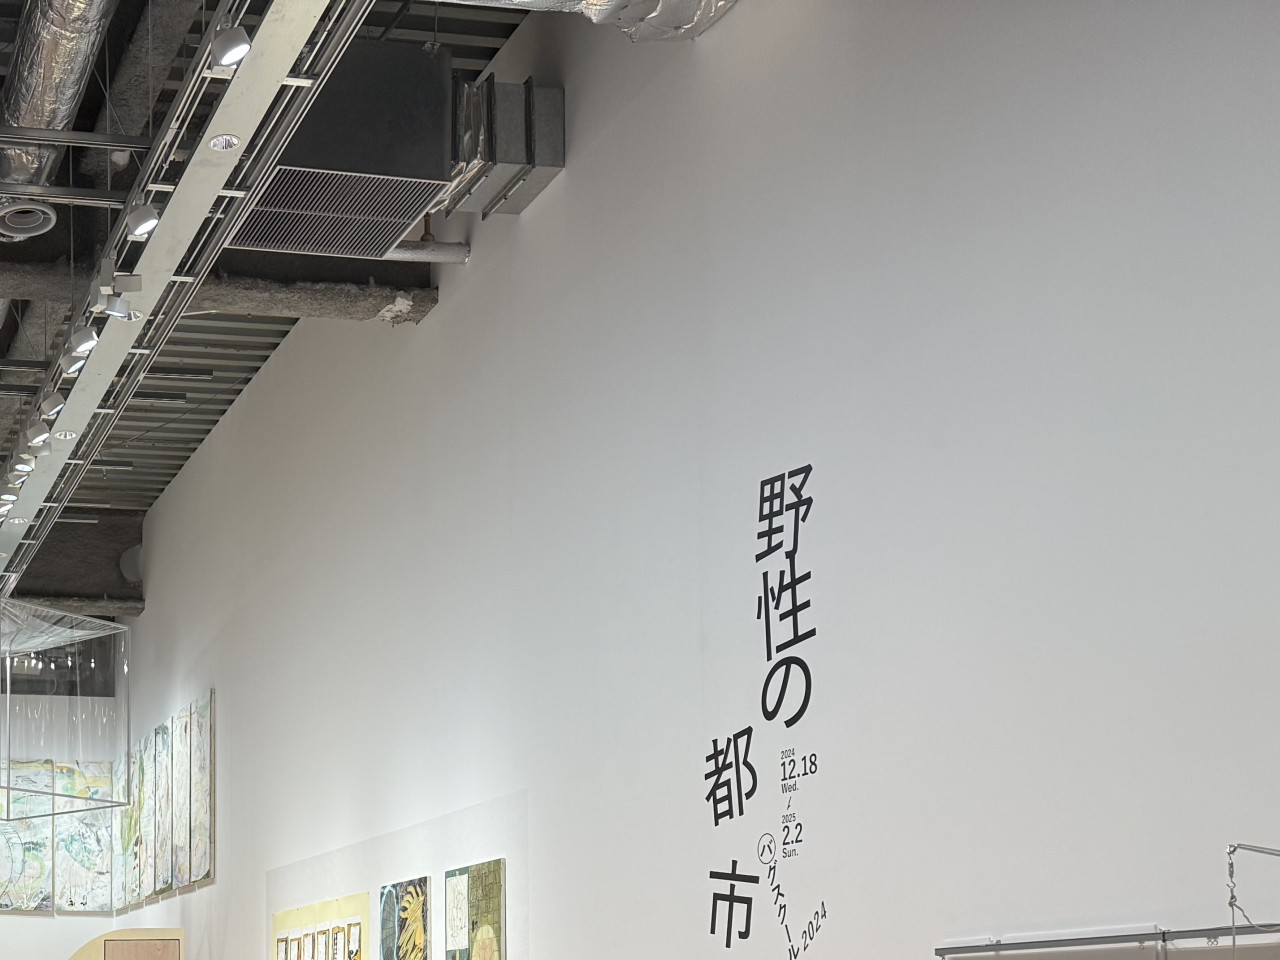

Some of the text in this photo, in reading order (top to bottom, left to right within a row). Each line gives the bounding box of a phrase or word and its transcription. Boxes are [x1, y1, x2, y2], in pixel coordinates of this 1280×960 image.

[780, 748, 795, 760] 2024
[780, 753, 818, 781] 12.18
[781, 780, 799, 794] Wed.
[781, 812, 796, 824] 2025
[782, 822, 803, 846] 2.2
[782, 847, 799, 858] Sun.
[801, 900, 827, 952] 2024
